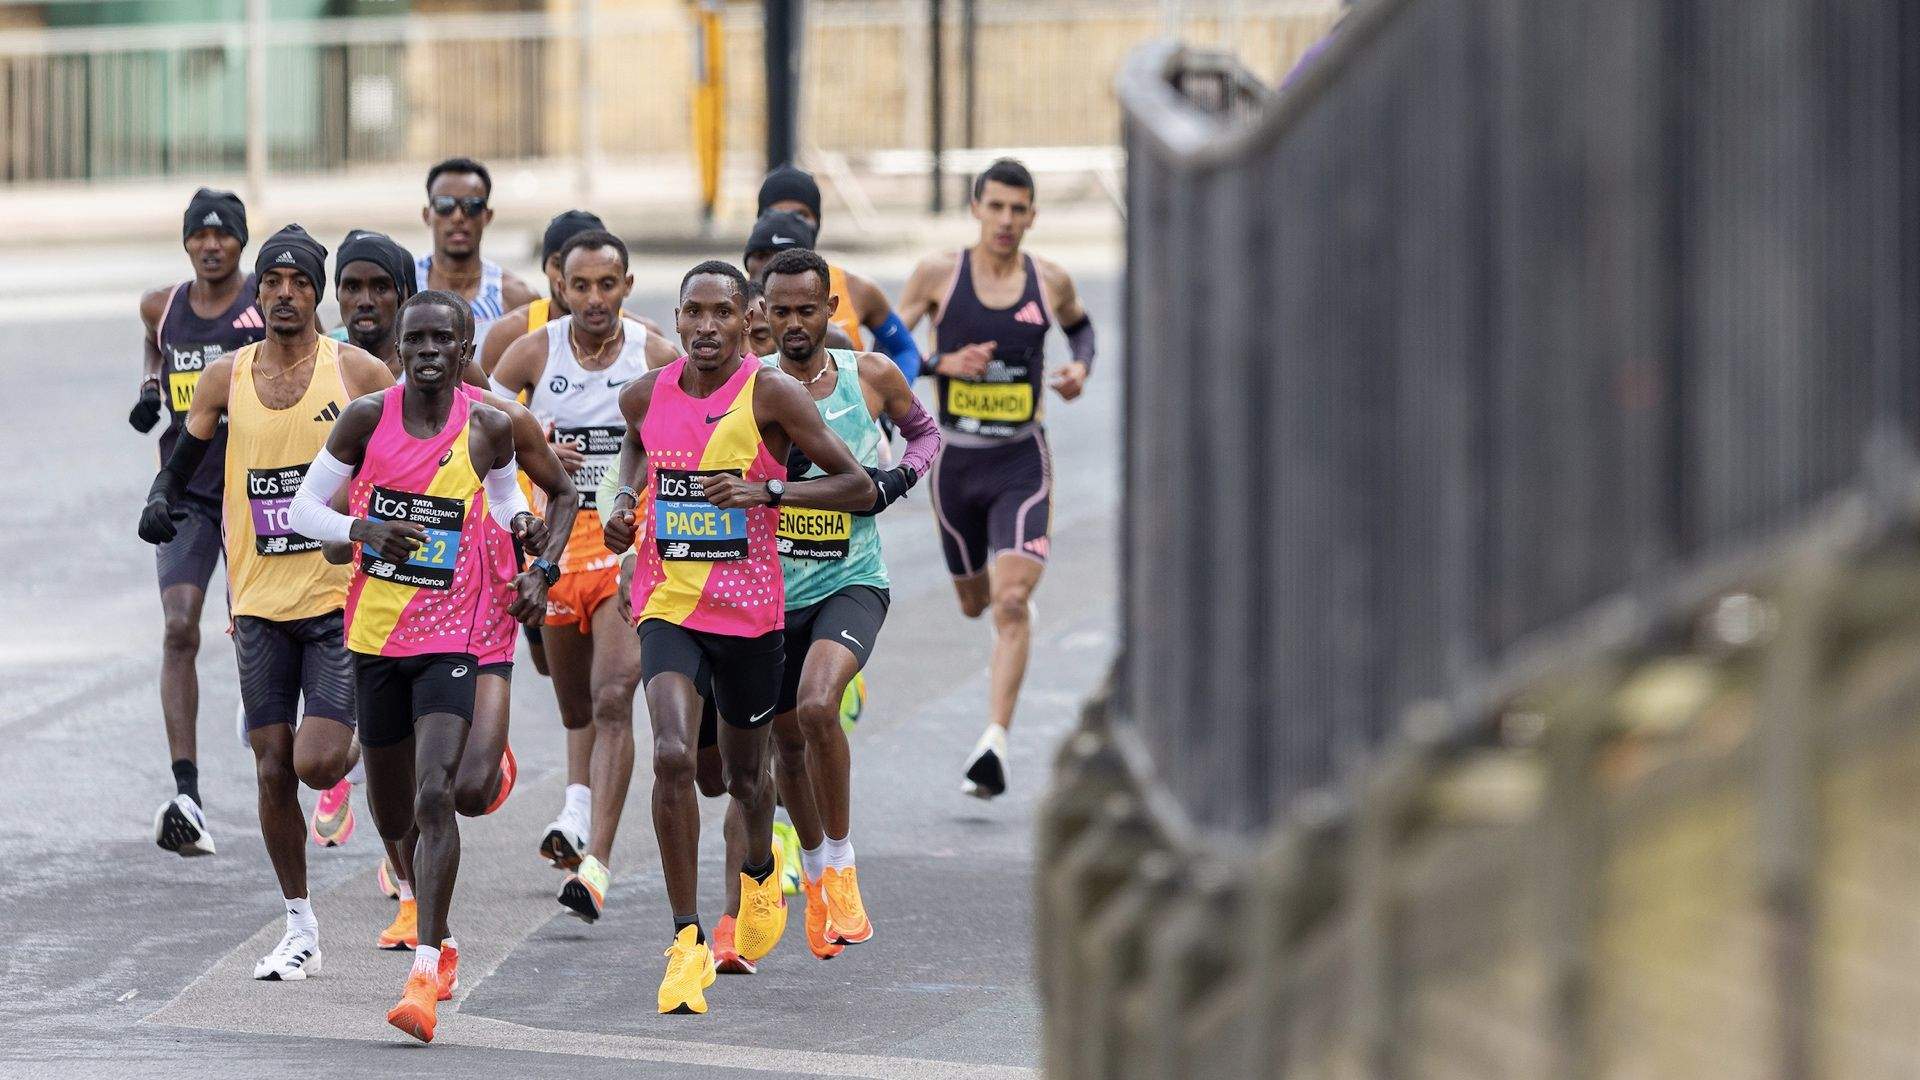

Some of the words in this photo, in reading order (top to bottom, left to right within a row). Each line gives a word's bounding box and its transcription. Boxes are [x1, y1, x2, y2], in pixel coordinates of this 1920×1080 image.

[174, 349, 202, 370] tcs
[279, 470, 300, 479] TATA
[573, 466, 608, 486] EBRES
[250, 473, 278, 495] tcs
[661, 474, 687, 496] tcs
[374, 492, 407, 519] tcs
[412, 499, 433, 507] TATA
[410, 514, 441, 524] SERVICES
[411, 506, 459, 518] CONSULTANCY
[666, 512, 717, 535] PACE
[720, 512, 731, 535] 1
[779, 513, 844, 536] ENGESHA
[289, 543, 304, 551] new
[432, 540, 446, 564] 2
[707, 550, 740, 558] balance
[810, 549, 842, 558] balance
[395, 574, 410, 582] new
[412, 576, 444, 586] balance
